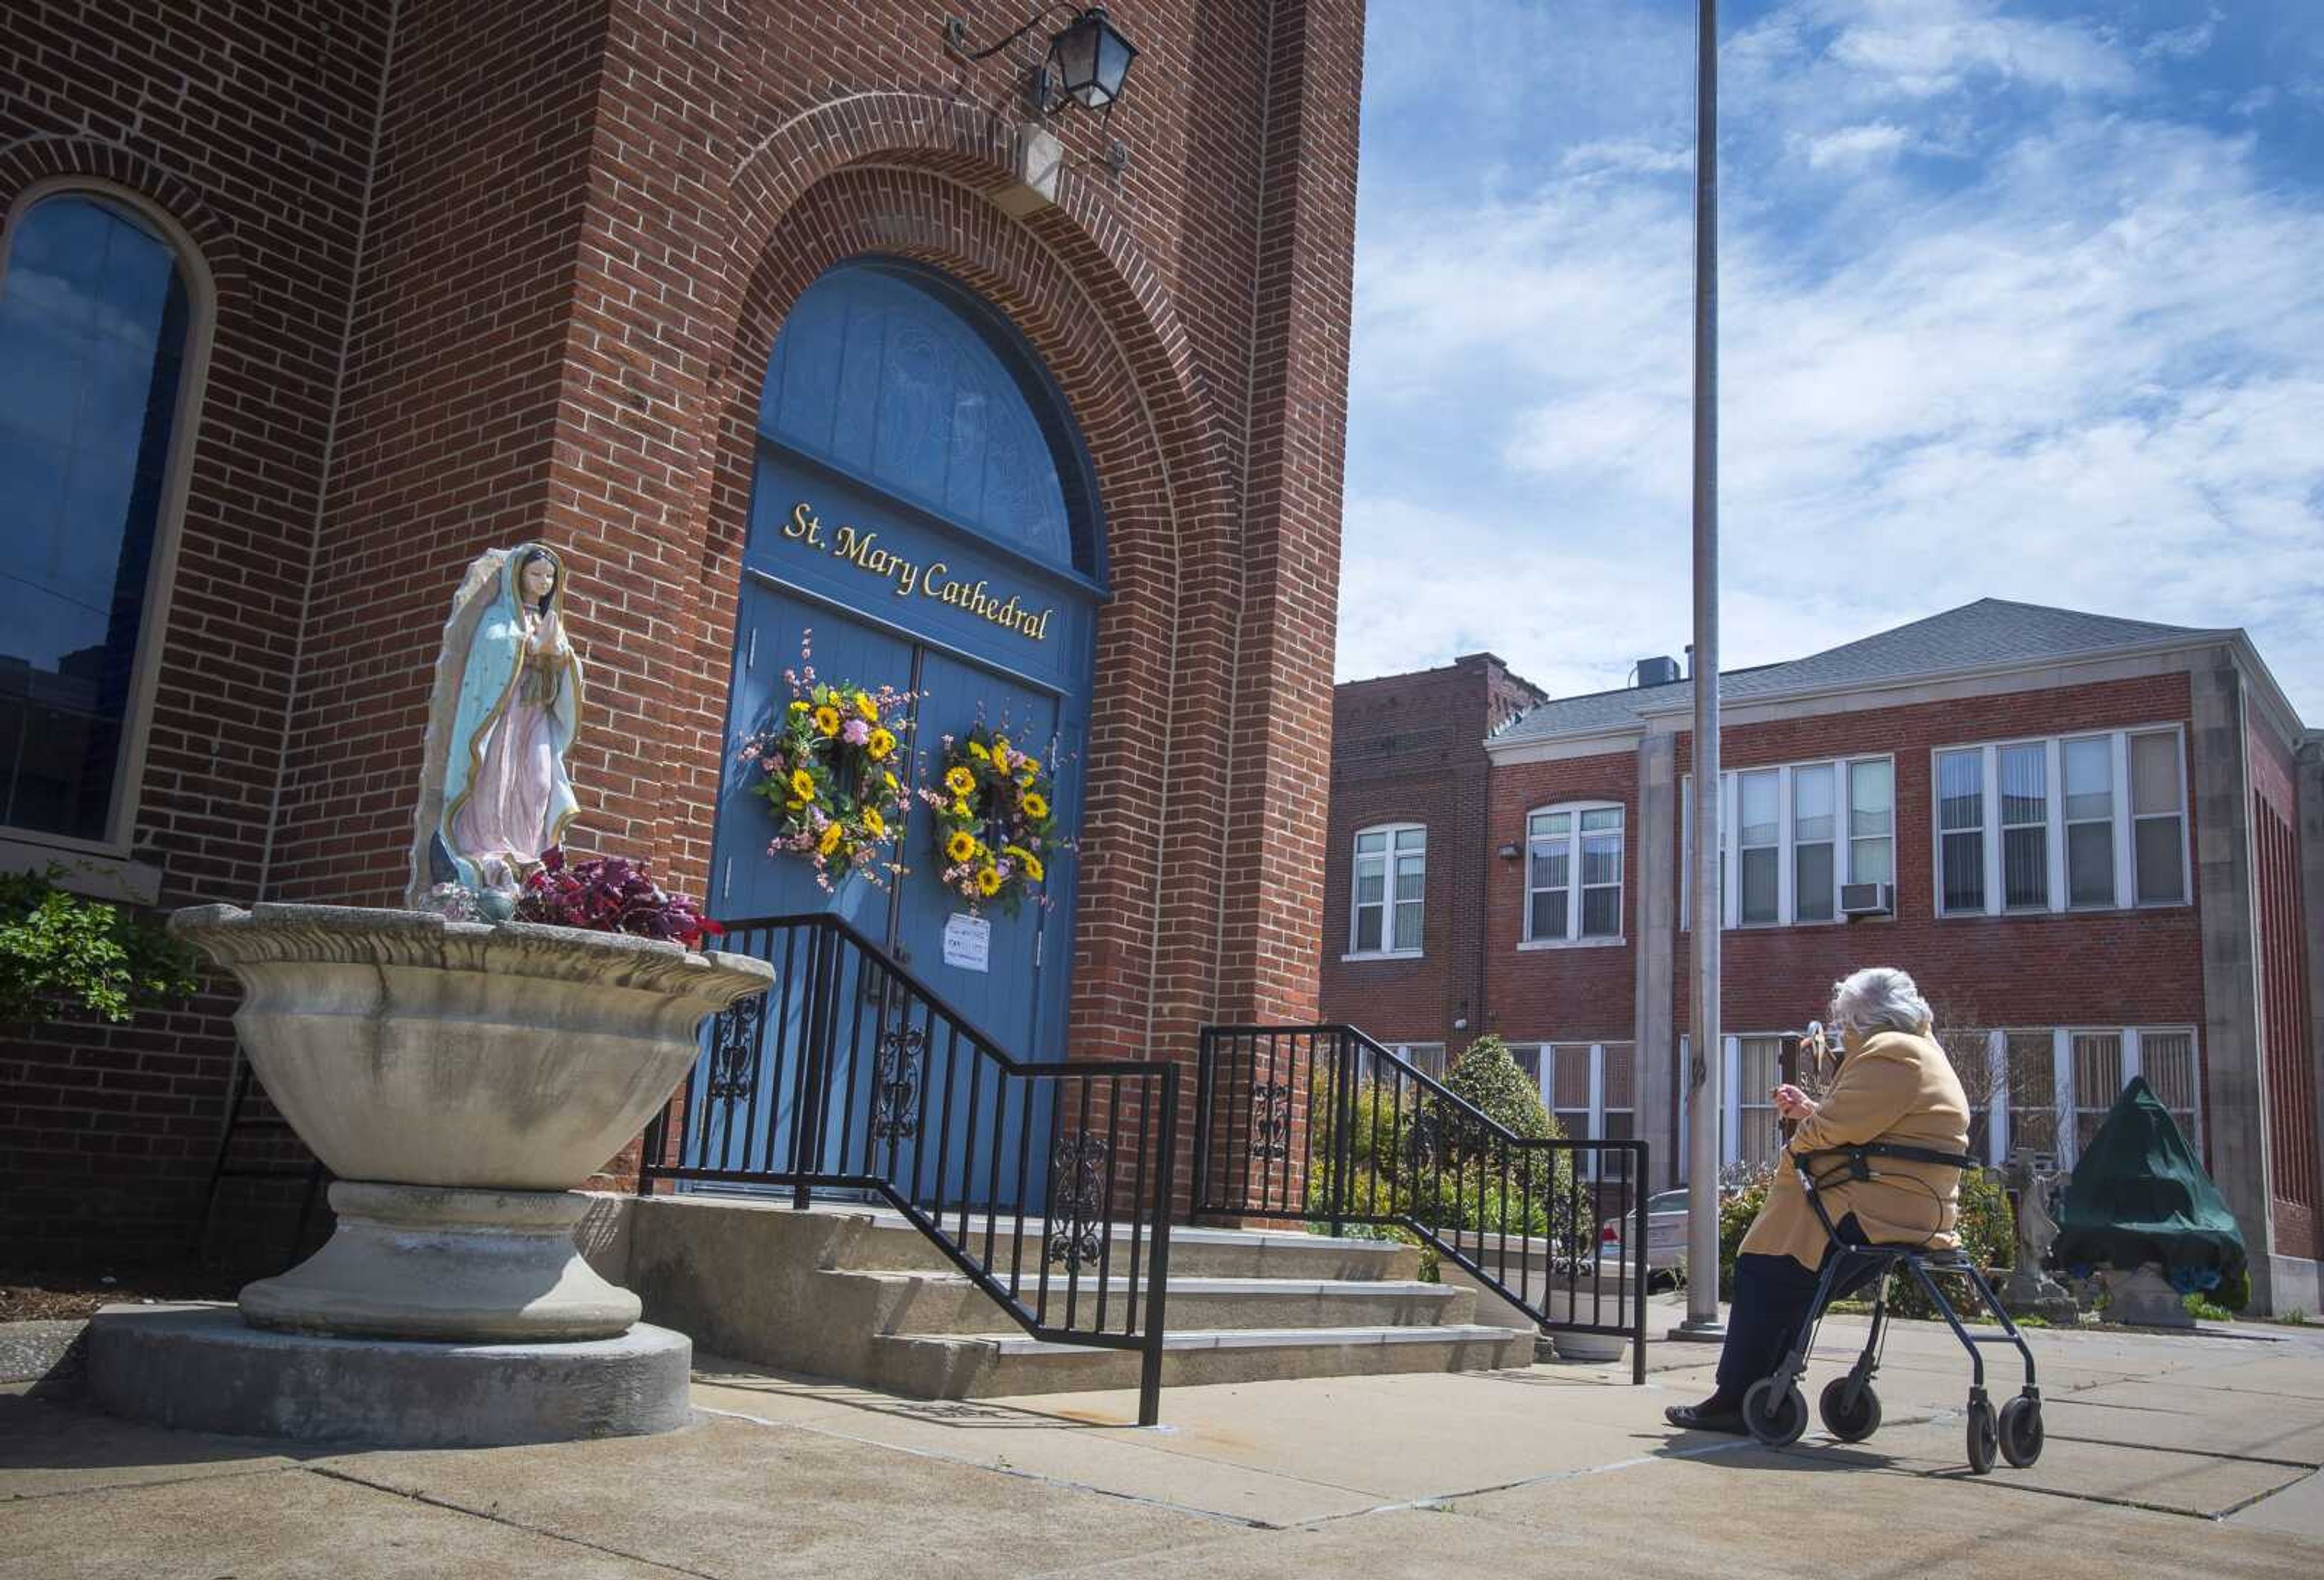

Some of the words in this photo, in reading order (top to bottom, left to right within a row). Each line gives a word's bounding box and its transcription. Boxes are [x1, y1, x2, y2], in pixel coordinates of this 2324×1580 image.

[785, 503, 826, 549] St.
[835, 527, 918, 595] Mary
[924, 563, 1052, 640] Cathedral
